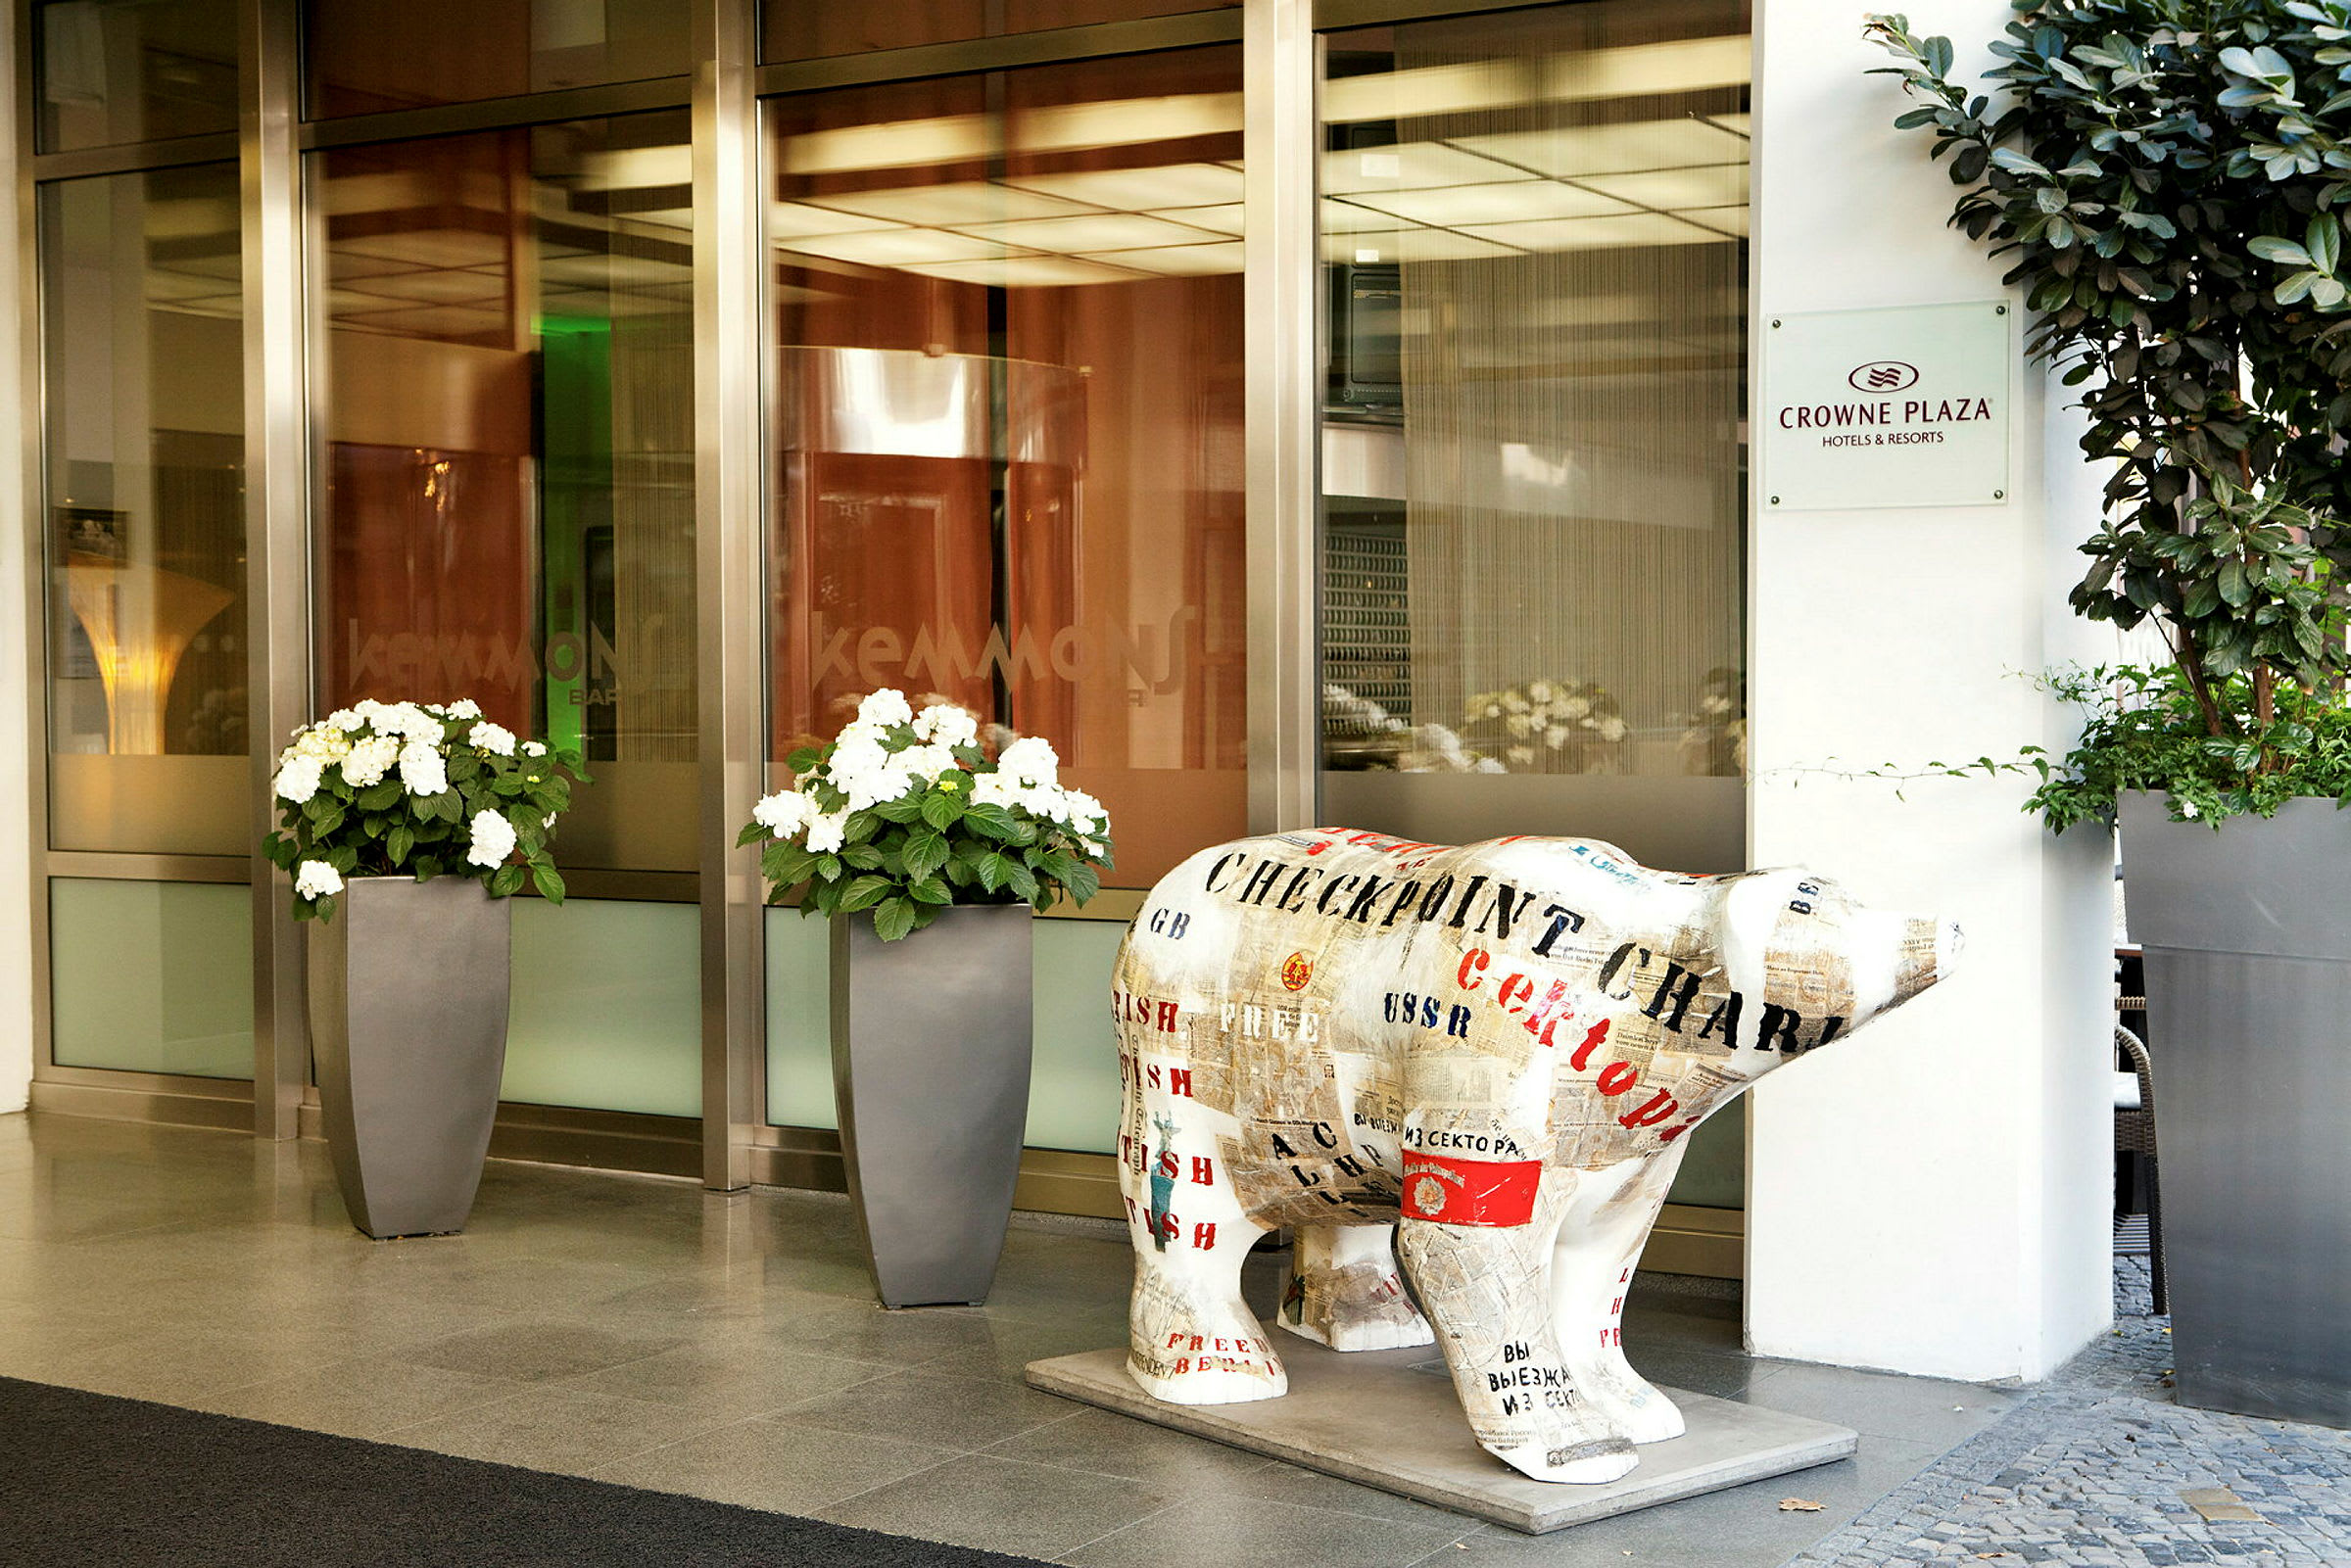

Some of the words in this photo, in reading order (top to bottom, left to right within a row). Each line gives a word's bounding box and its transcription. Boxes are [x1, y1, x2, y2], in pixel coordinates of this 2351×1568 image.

[1779, 402, 1892, 429] CROWNE
[1904, 398, 1991, 423] PLAZA
[1822, 434, 1872, 448] HOTELS
[1875, 434, 1885, 446] &
[1888, 431, 1944, 445] RESORTS
[1206, 852, 1586, 959] CHECKPOINT
[1150, 908, 1191, 940] GB
[1221, 1001, 1319, 1043] FREE
[1384, 992, 1472, 1040] USSR
[1504, 1341, 1530, 1364] ВЫ
